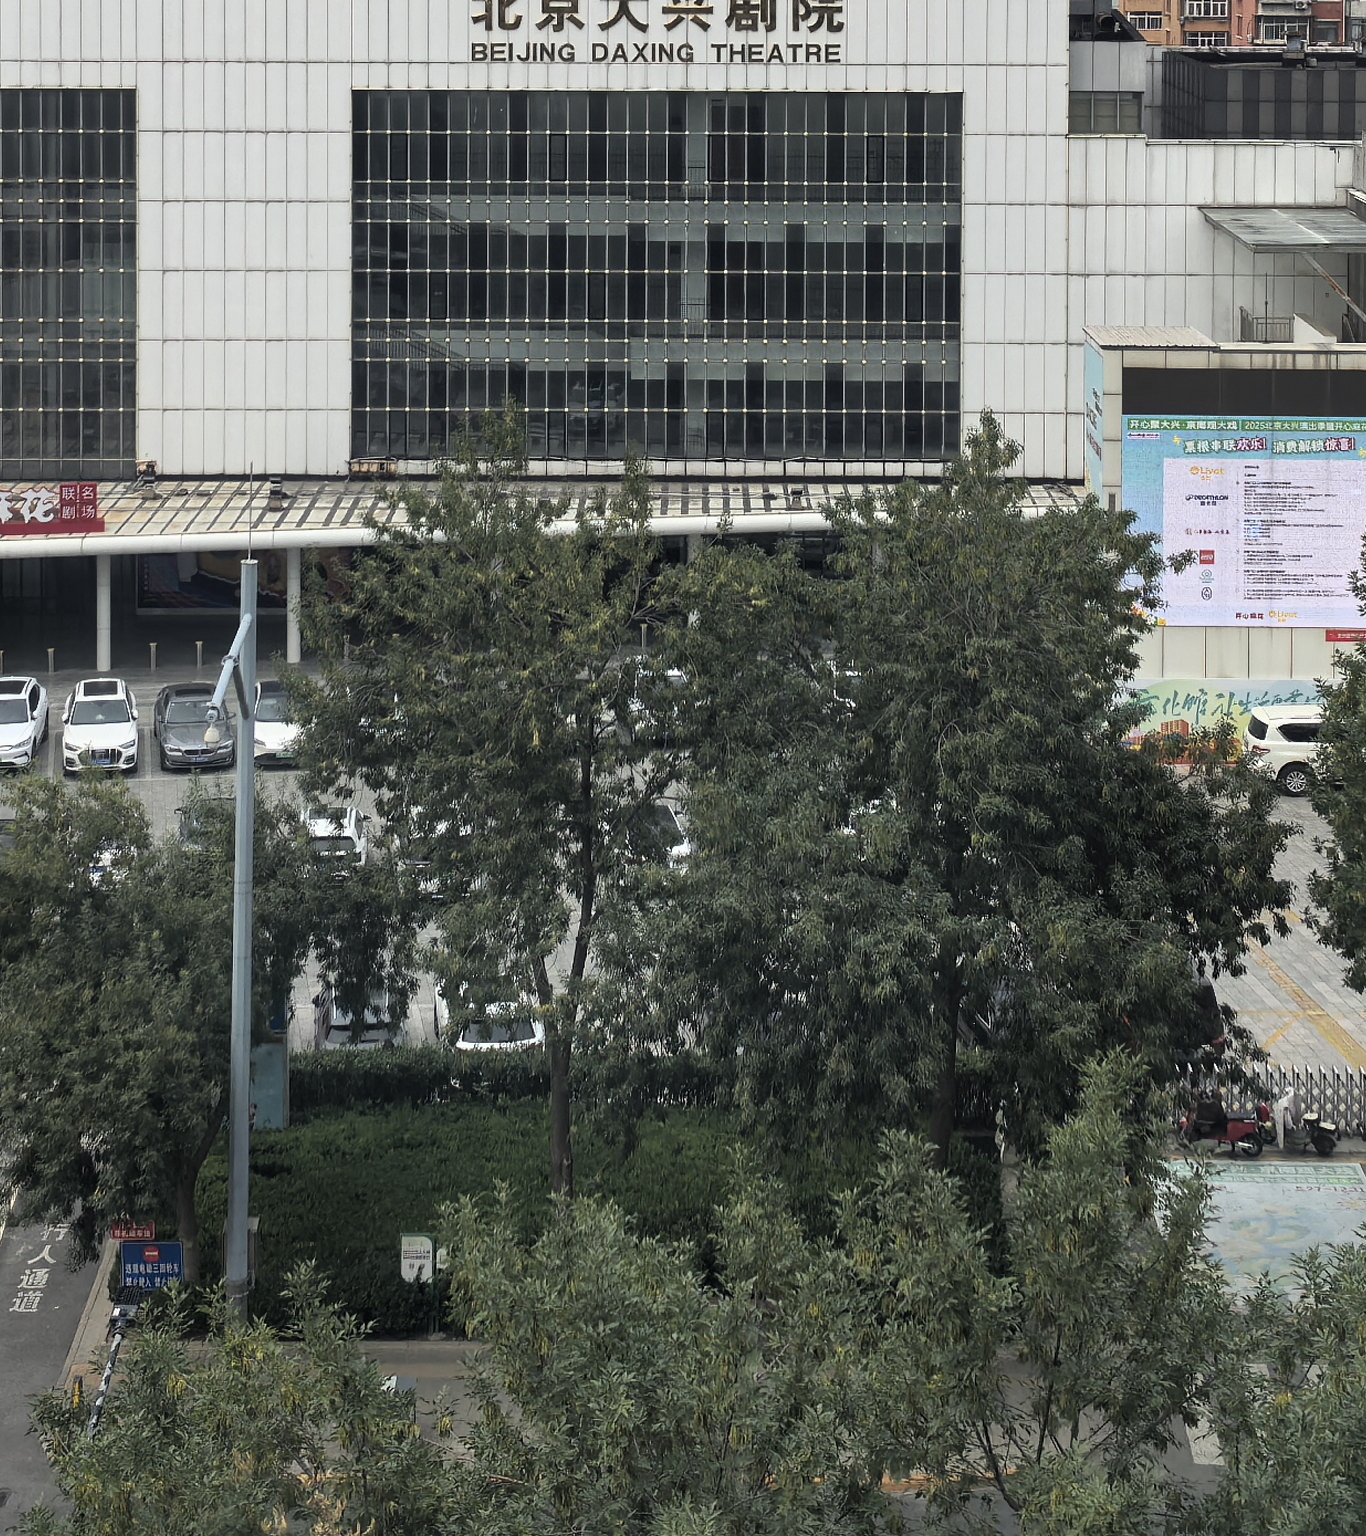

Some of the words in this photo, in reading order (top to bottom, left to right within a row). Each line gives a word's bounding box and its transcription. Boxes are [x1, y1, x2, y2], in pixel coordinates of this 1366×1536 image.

[471, 42, 575, 62] BEIJING
[592, 42, 694, 63] DAXING
[710, 43, 841, 63] THEATRE
[9, 1221, 72, 1313] 行人通道
